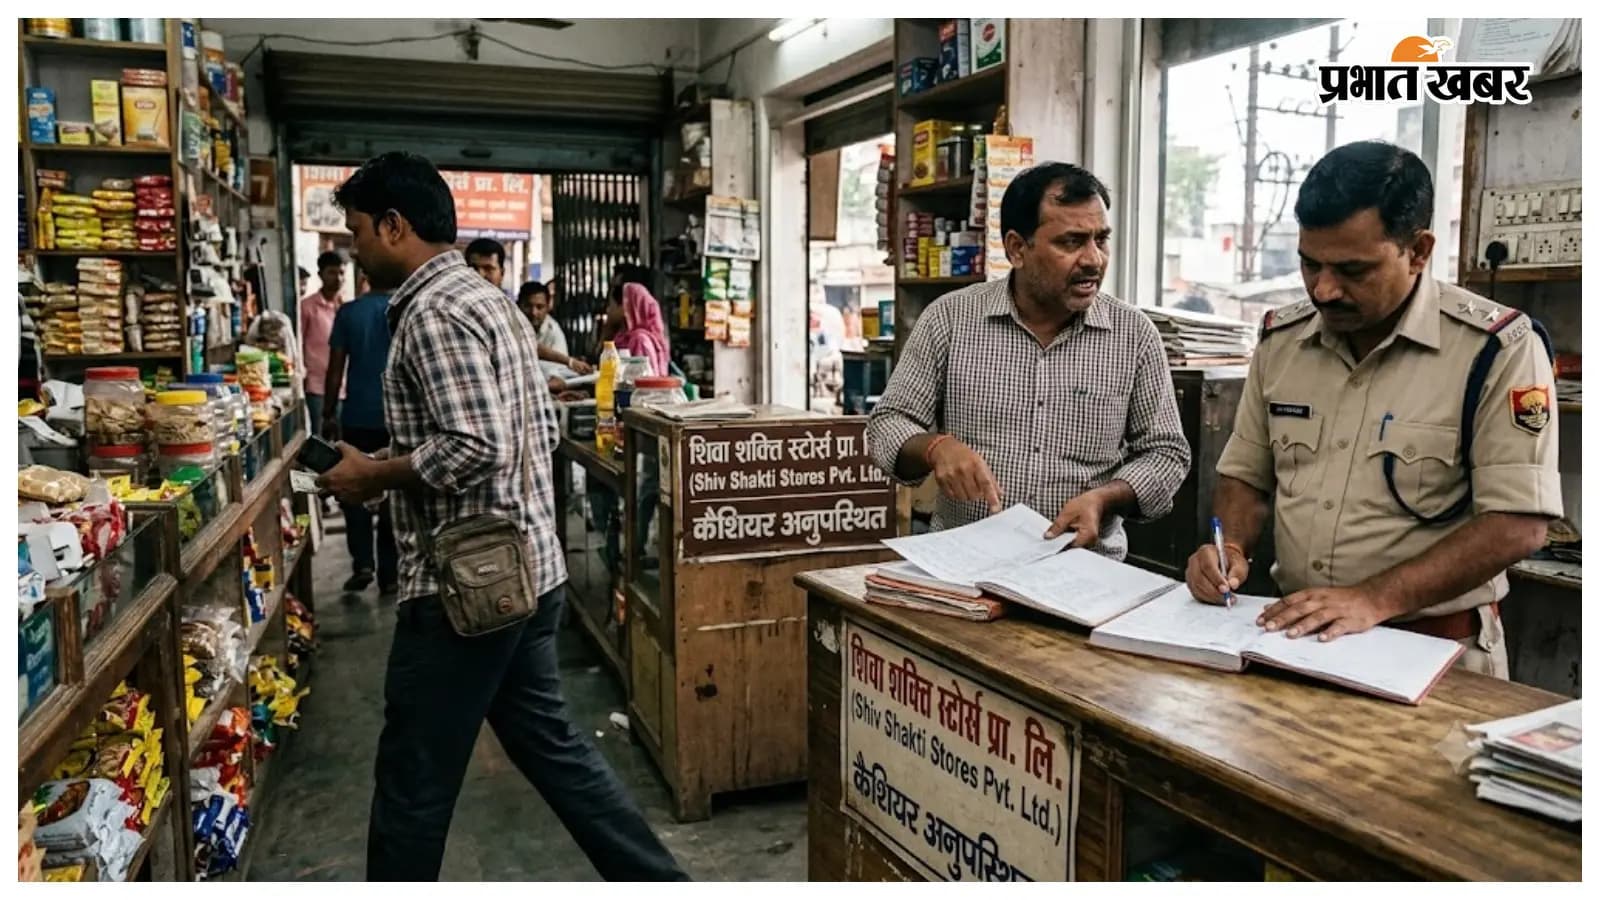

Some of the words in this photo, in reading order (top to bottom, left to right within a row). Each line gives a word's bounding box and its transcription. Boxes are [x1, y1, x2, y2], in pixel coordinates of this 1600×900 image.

[689, 432, 731, 465] शिवा
[735, 431, 783, 463] शक्ति
[788, 430, 831, 461] स्टोर्स
[836, 436, 858, 461] प्रा.
[689, 471, 726, 496] (Shiv
[730, 468, 776, 491] Shakti
[780, 470, 826, 488] Stores
[829, 466, 856, 485] Pvt.
[693, 505, 776, 541] कैशियर
[780, 498, 888, 546] अनुपस्थित
[851, 633, 885, 693] शिवा
[888, 656, 934, 718] शक्ति
[937, 679, 983, 746] स्टोर्स
[986, 710, 1016, 765] प्रा.
[1024, 716, 1063, 791] लि.
[851, 688, 882, 730] (Shiv
[884, 709, 926, 758] Shakti
[930, 736, 979, 789] Stores
[983, 765, 1015, 812] Pvt.
[1021, 786, 1062, 846] Ltd.)
[853, 751, 920, 835] कैशियर
[923, 811, 1038, 882] अनुपस्थि
